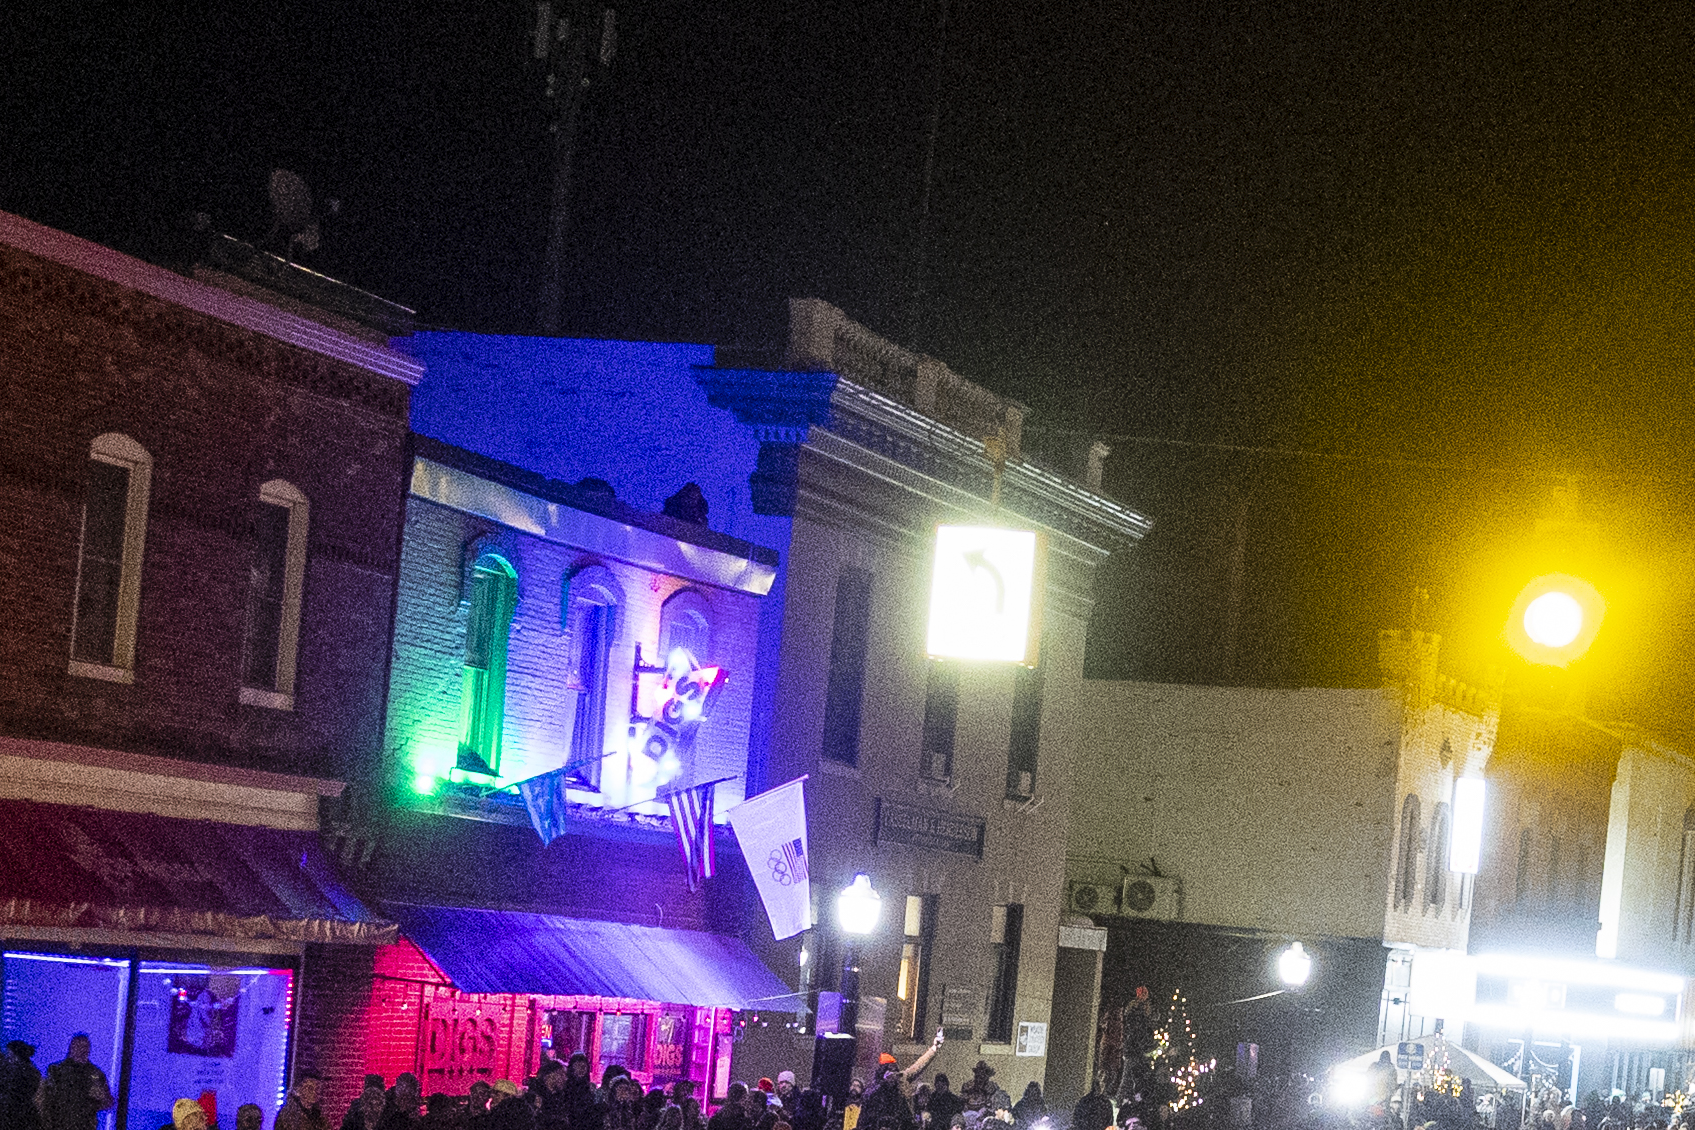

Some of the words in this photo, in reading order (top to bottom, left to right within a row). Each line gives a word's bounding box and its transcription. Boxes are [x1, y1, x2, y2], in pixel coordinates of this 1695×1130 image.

[643, 675, 701, 762] DIGS
[429, 1017, 496, 1062] DIGS
[653, 1044, 683, 1067] DIGS
